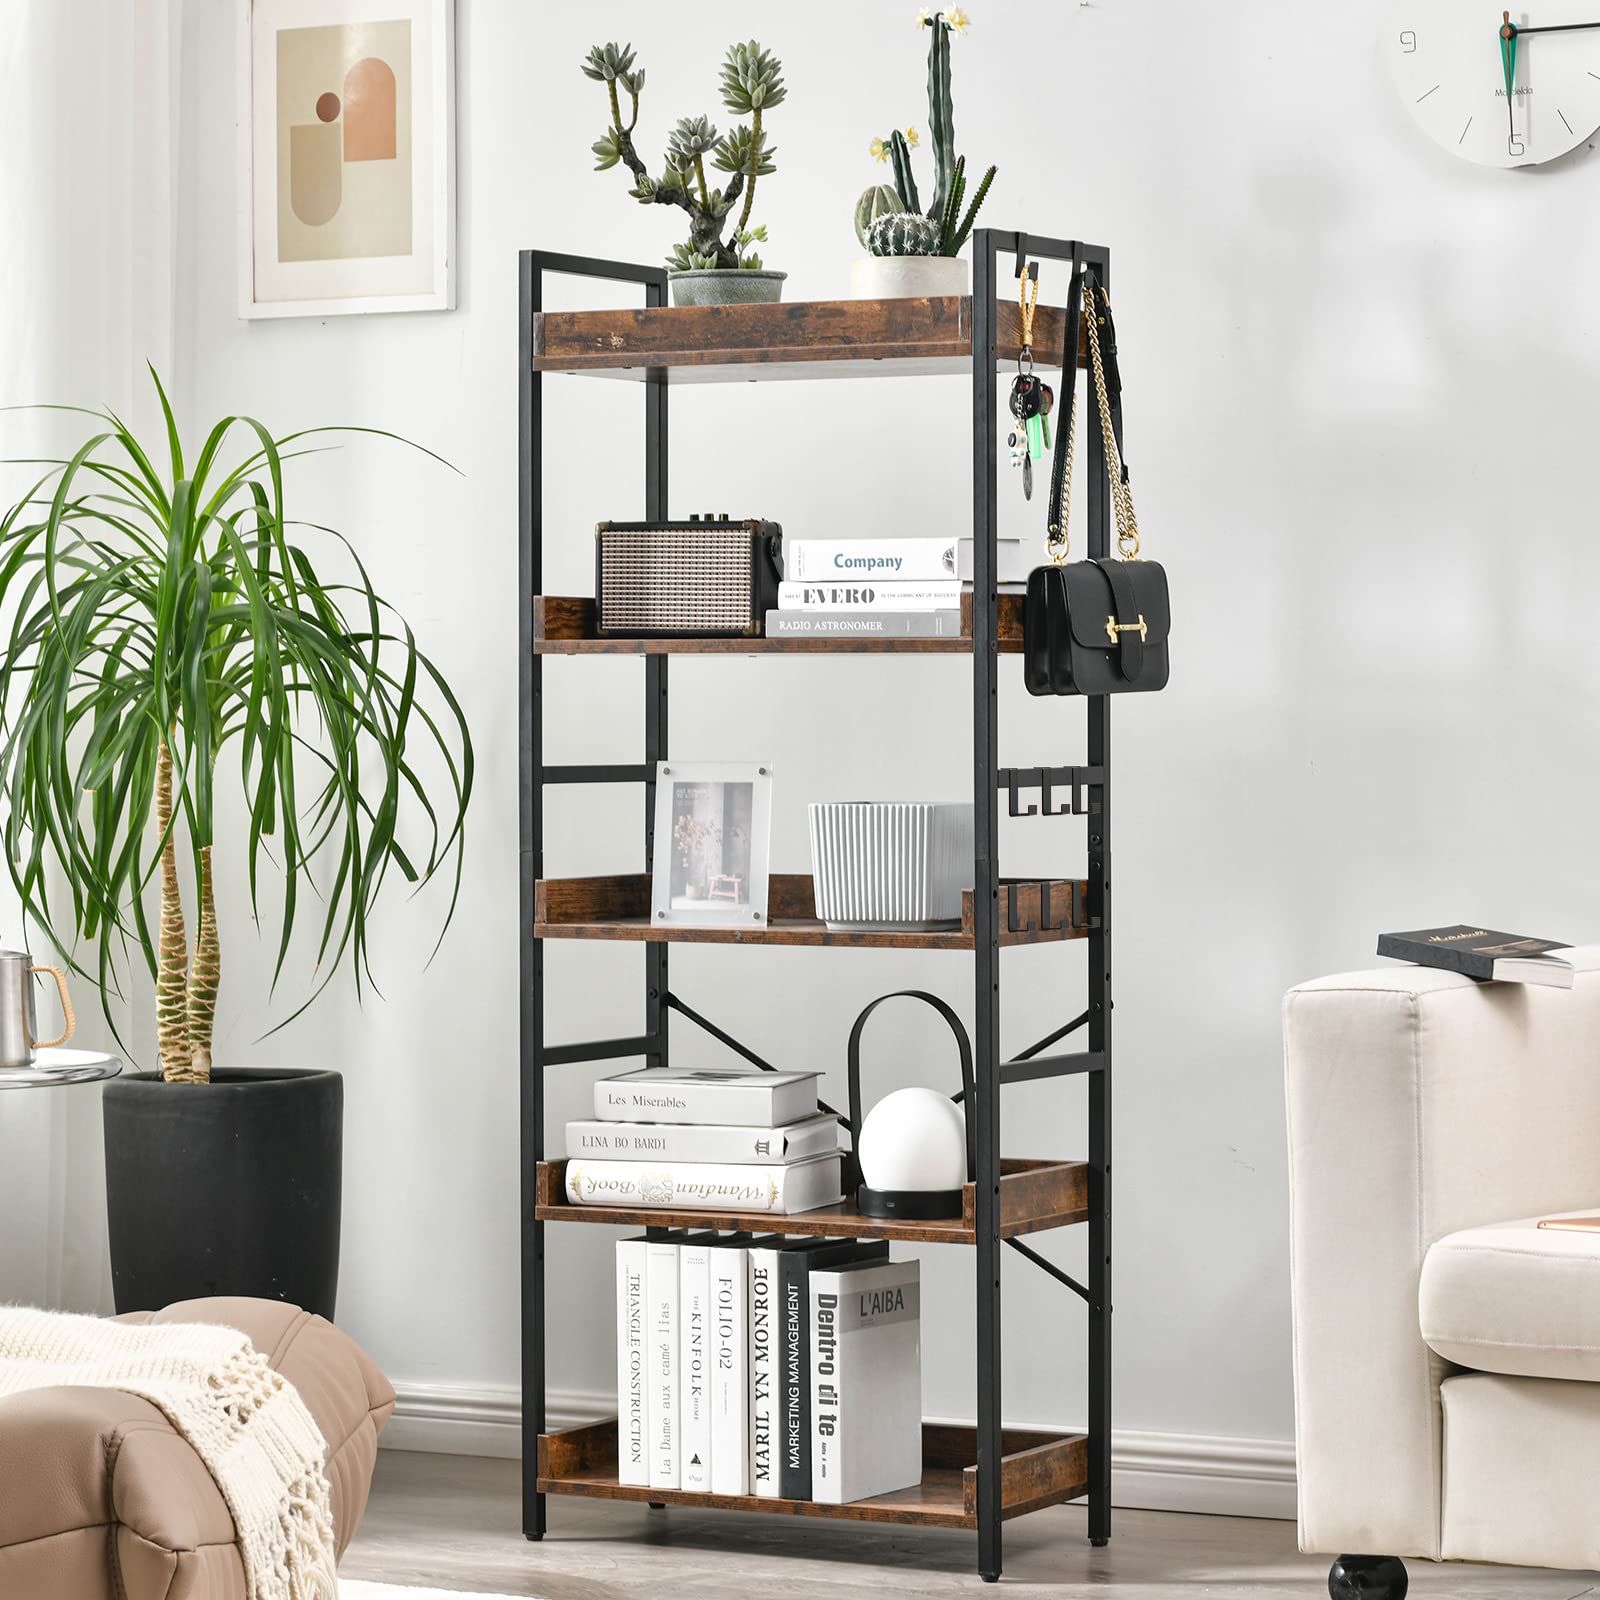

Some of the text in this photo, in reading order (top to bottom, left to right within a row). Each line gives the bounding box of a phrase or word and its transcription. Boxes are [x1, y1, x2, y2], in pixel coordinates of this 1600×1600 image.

[833, 553, 903, 571] Company
[803, 588, 875, 604] EVERO
[779, 620, 883, 631] RADIO ASTRONOMER
[608, 1094, 687, 1109] Les Miserables
[582, 1135, 667, 1150] LINA BO BARDI
[584, 1175, 764, 1200] Wandian Book
[658, 1302, 670, 1333] lias
[860, 1288, 904, 1318] L'AIBA
[718, 1278, 733, 1370] FOLIO-02
[630, 1273, 642, 1464] TRIANGLE CONSTRUCTION
[691, 1312, 702, 1396] KINFOLK
[817, 1293, 838, 1437] Dentro di te
[753, 1268, 770, 1482] MARIL YN MONROE
[787, 1283, 800, 1469] MARKETING MANAGEMENT
[662, 1384, 671, 1409] aux
[660, 1417, 671, 1451] Dame
[660, 1459, 671, 1476] La
